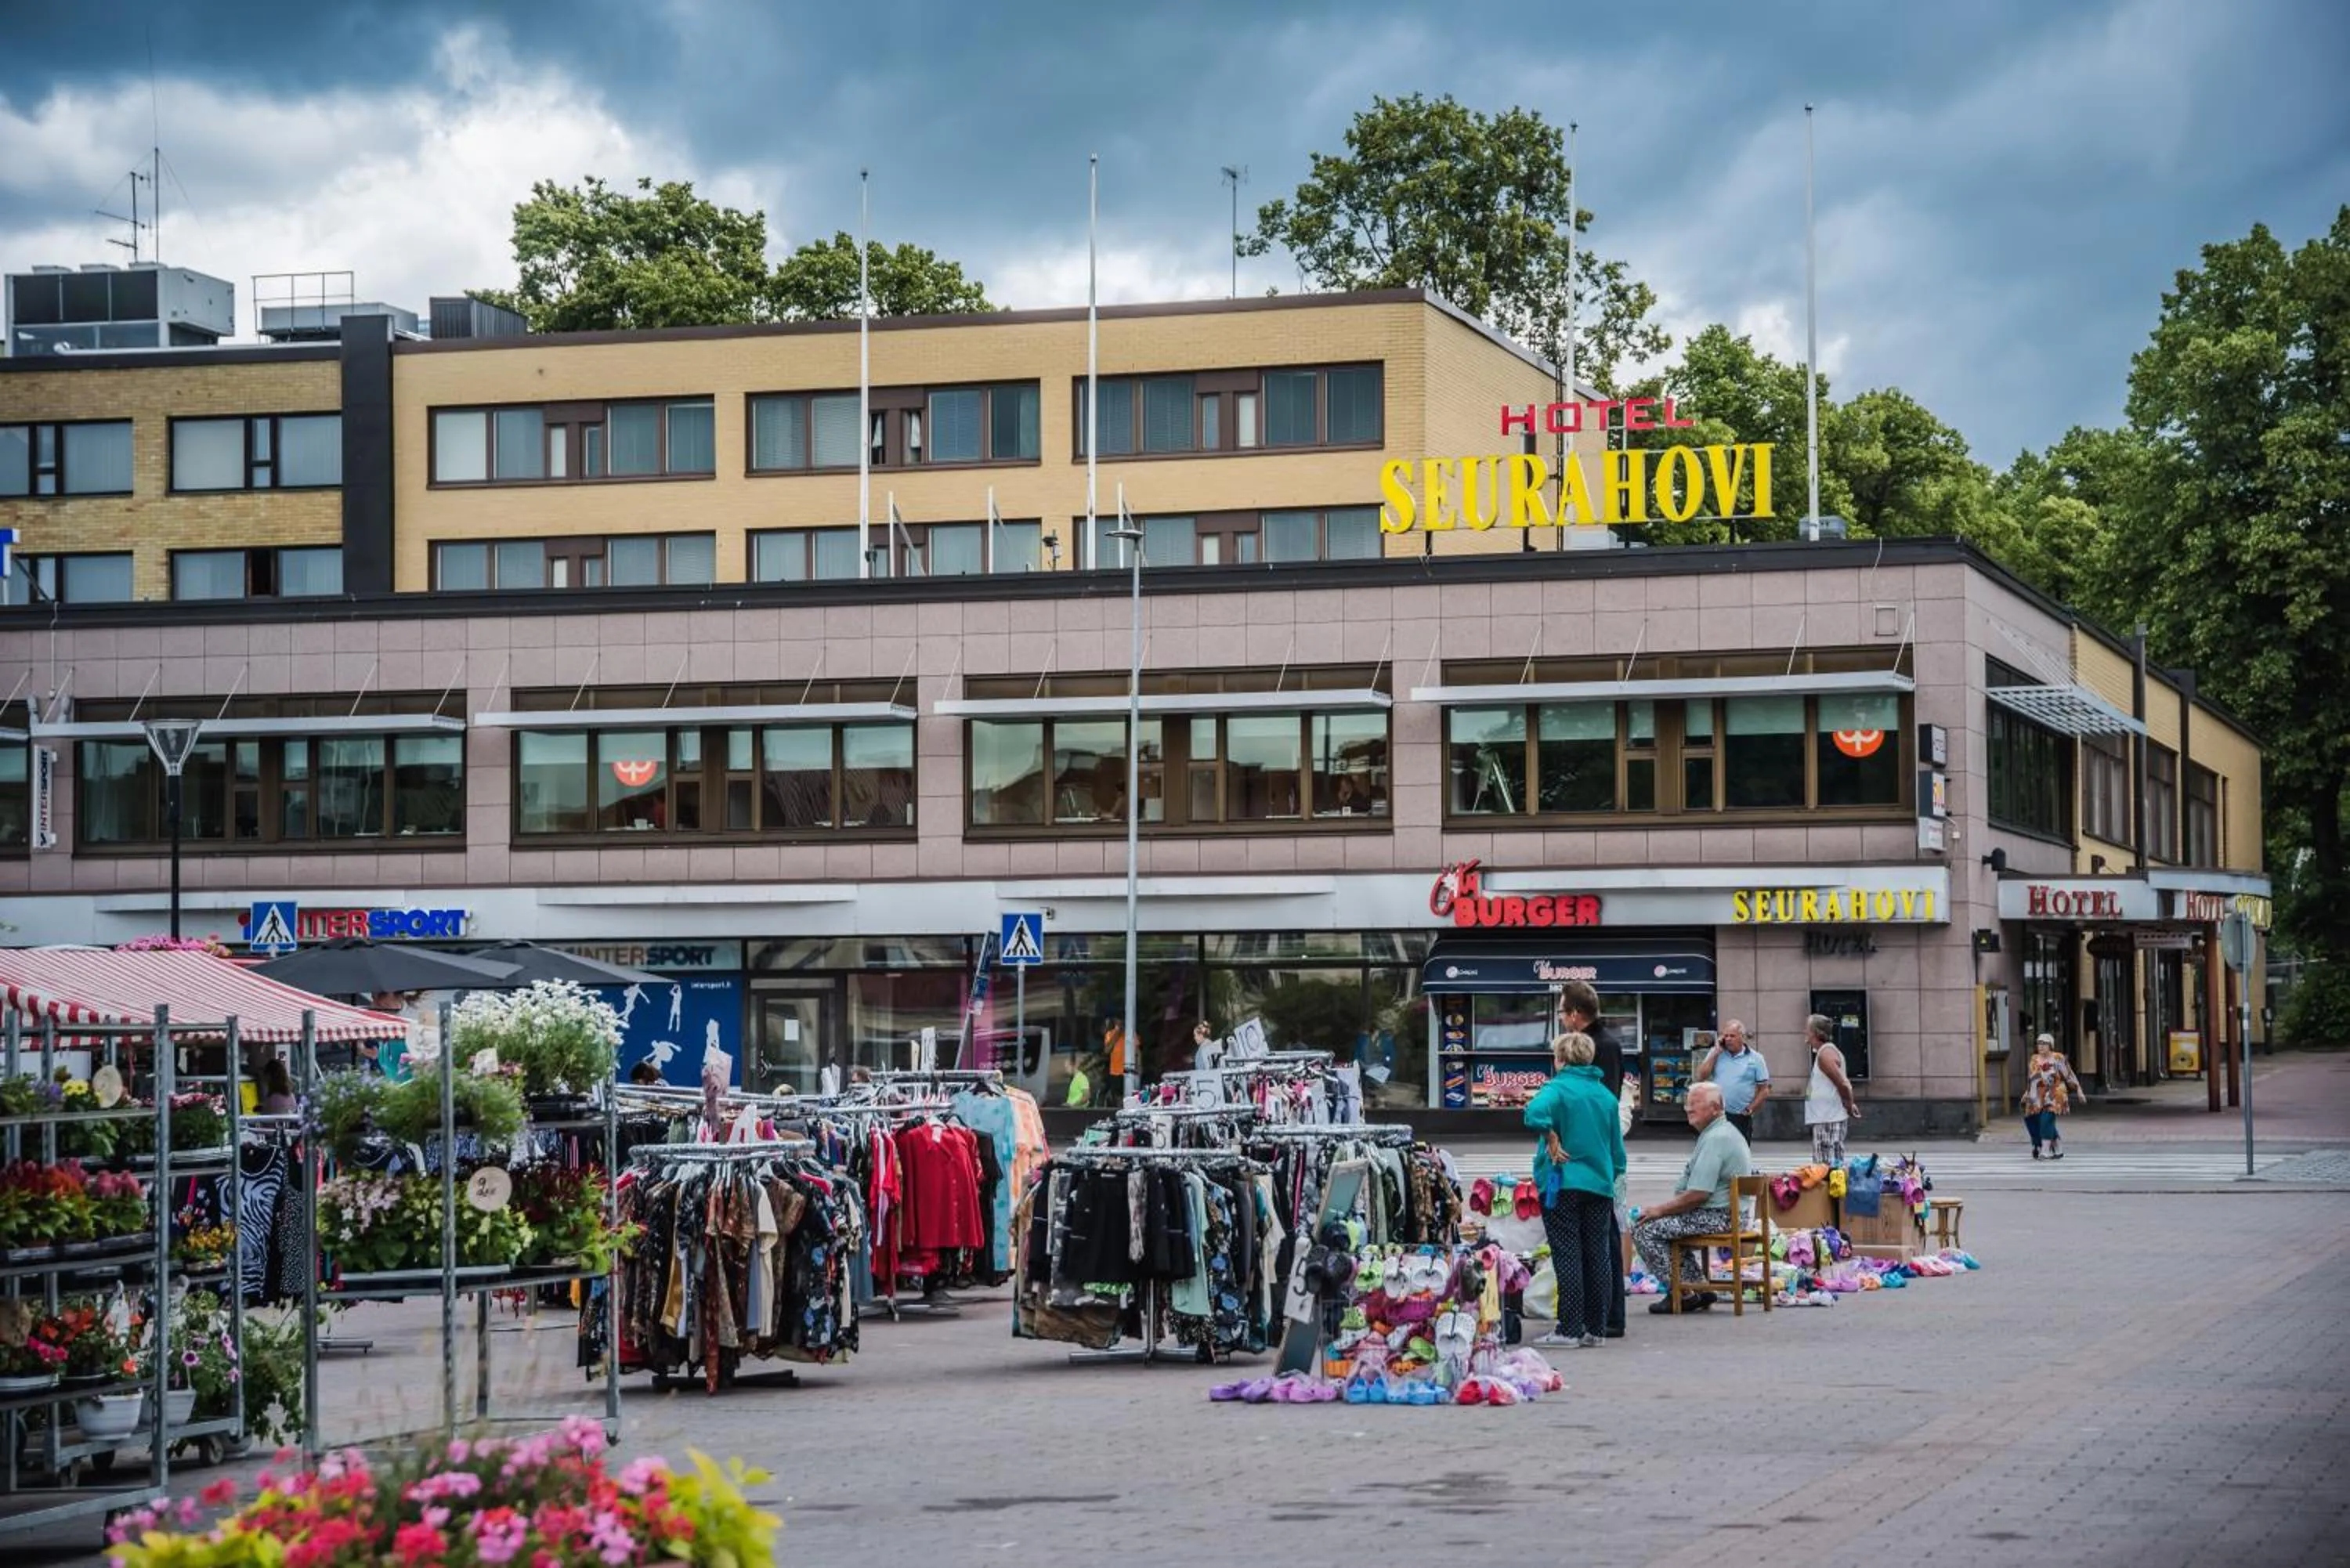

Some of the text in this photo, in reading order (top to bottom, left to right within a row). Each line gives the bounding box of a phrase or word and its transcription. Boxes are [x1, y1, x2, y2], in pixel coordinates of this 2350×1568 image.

[1501, 396, 1697, 435] HOTEL
[1379, 443, 1776, 534] SEURAHOVI
[1454, 894, 1601, 927] BURGER
[1732, 888, 1936, 923] SEURAHOVI
[2026, 885, 2124, 918] HOTEL
[298, 909, 465, 938] TERSPORT
[1484, 1071, 1546, 1086] BURGER
